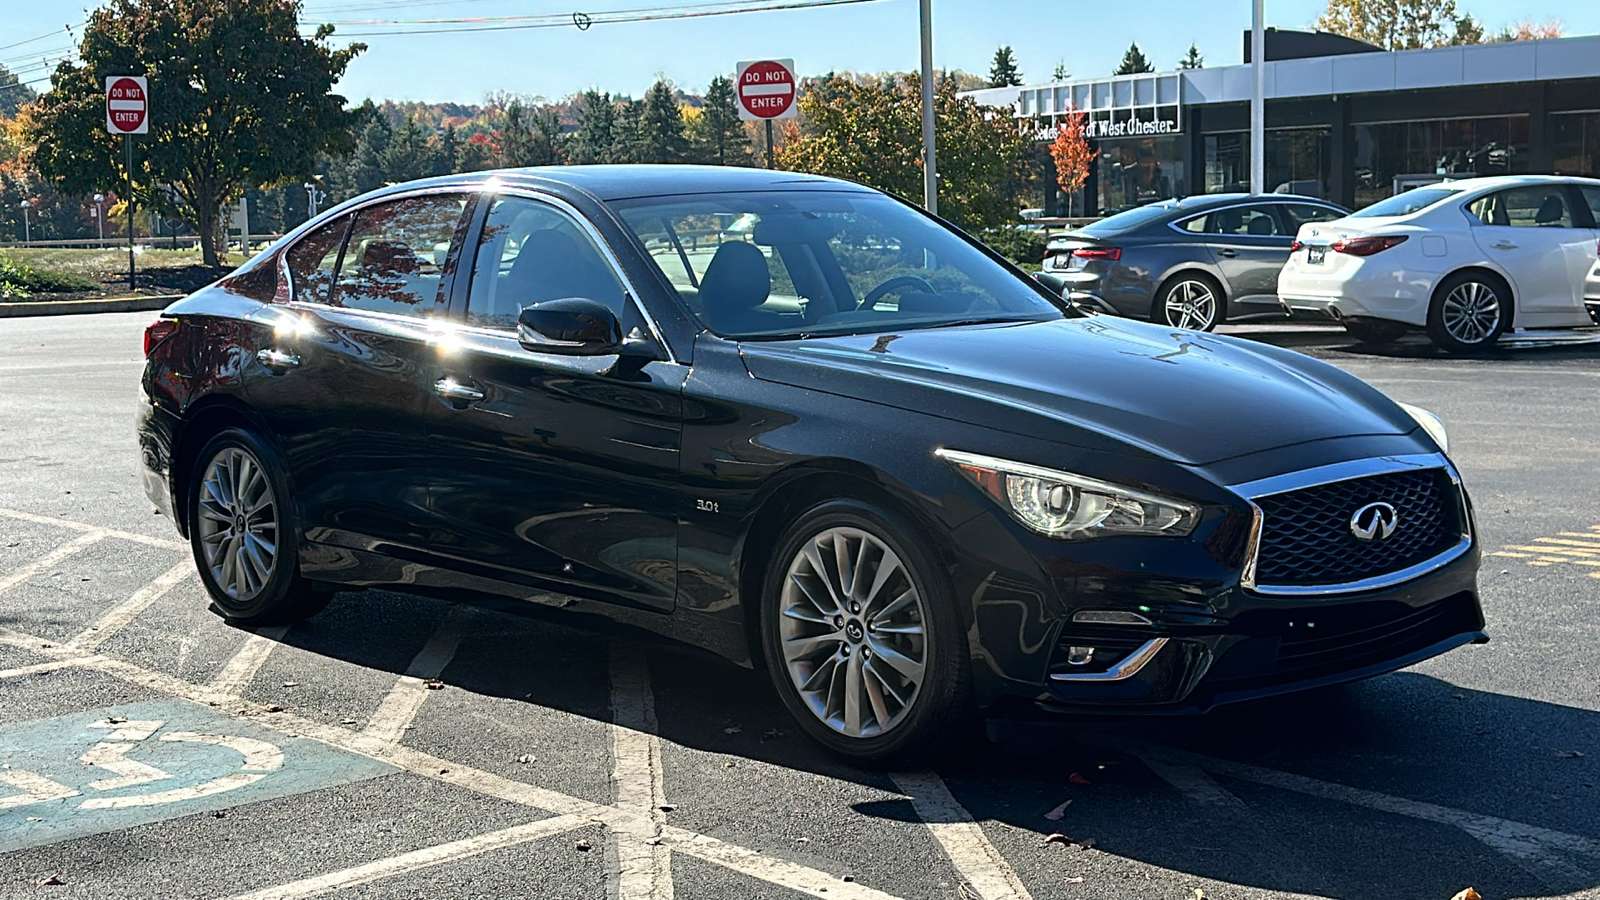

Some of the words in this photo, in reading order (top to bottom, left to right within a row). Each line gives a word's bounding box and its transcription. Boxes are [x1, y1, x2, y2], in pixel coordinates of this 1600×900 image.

[745, 72, 760, 82] DO
[765, 71, 786, 81] NOT
[112, 88, 123, 98] DO
[126, 88, 141, 98] NOT
[751, 97, 784, 108] ENTER
[115, 112, 139, 122] ENTER
[1086, 121, 1097, 137] of
[1099, 120, 1126, 136] West
[1127, 118, 1174, 135] Chester
